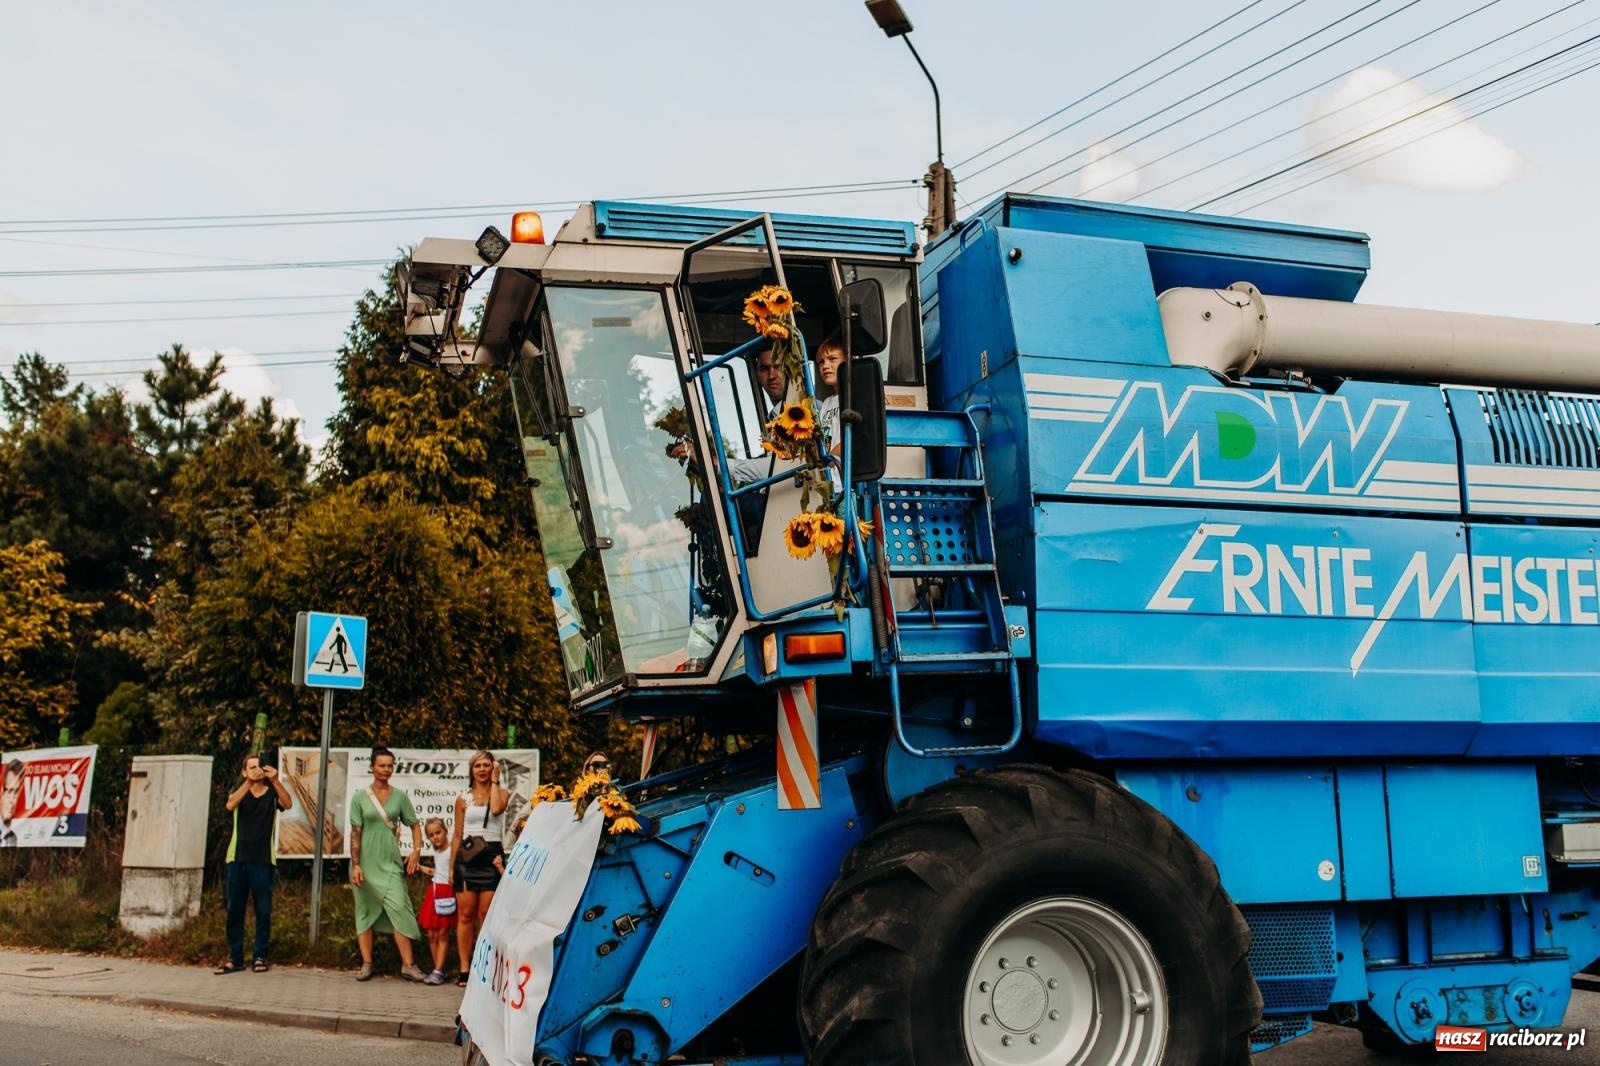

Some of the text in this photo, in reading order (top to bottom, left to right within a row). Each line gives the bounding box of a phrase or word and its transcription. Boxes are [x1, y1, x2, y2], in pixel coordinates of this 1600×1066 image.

[1072, 381, 1410, 495] MDW
[1350, 551, 1600, 678] MEISTE
[414, 788, 457, 798] Rybnicka
